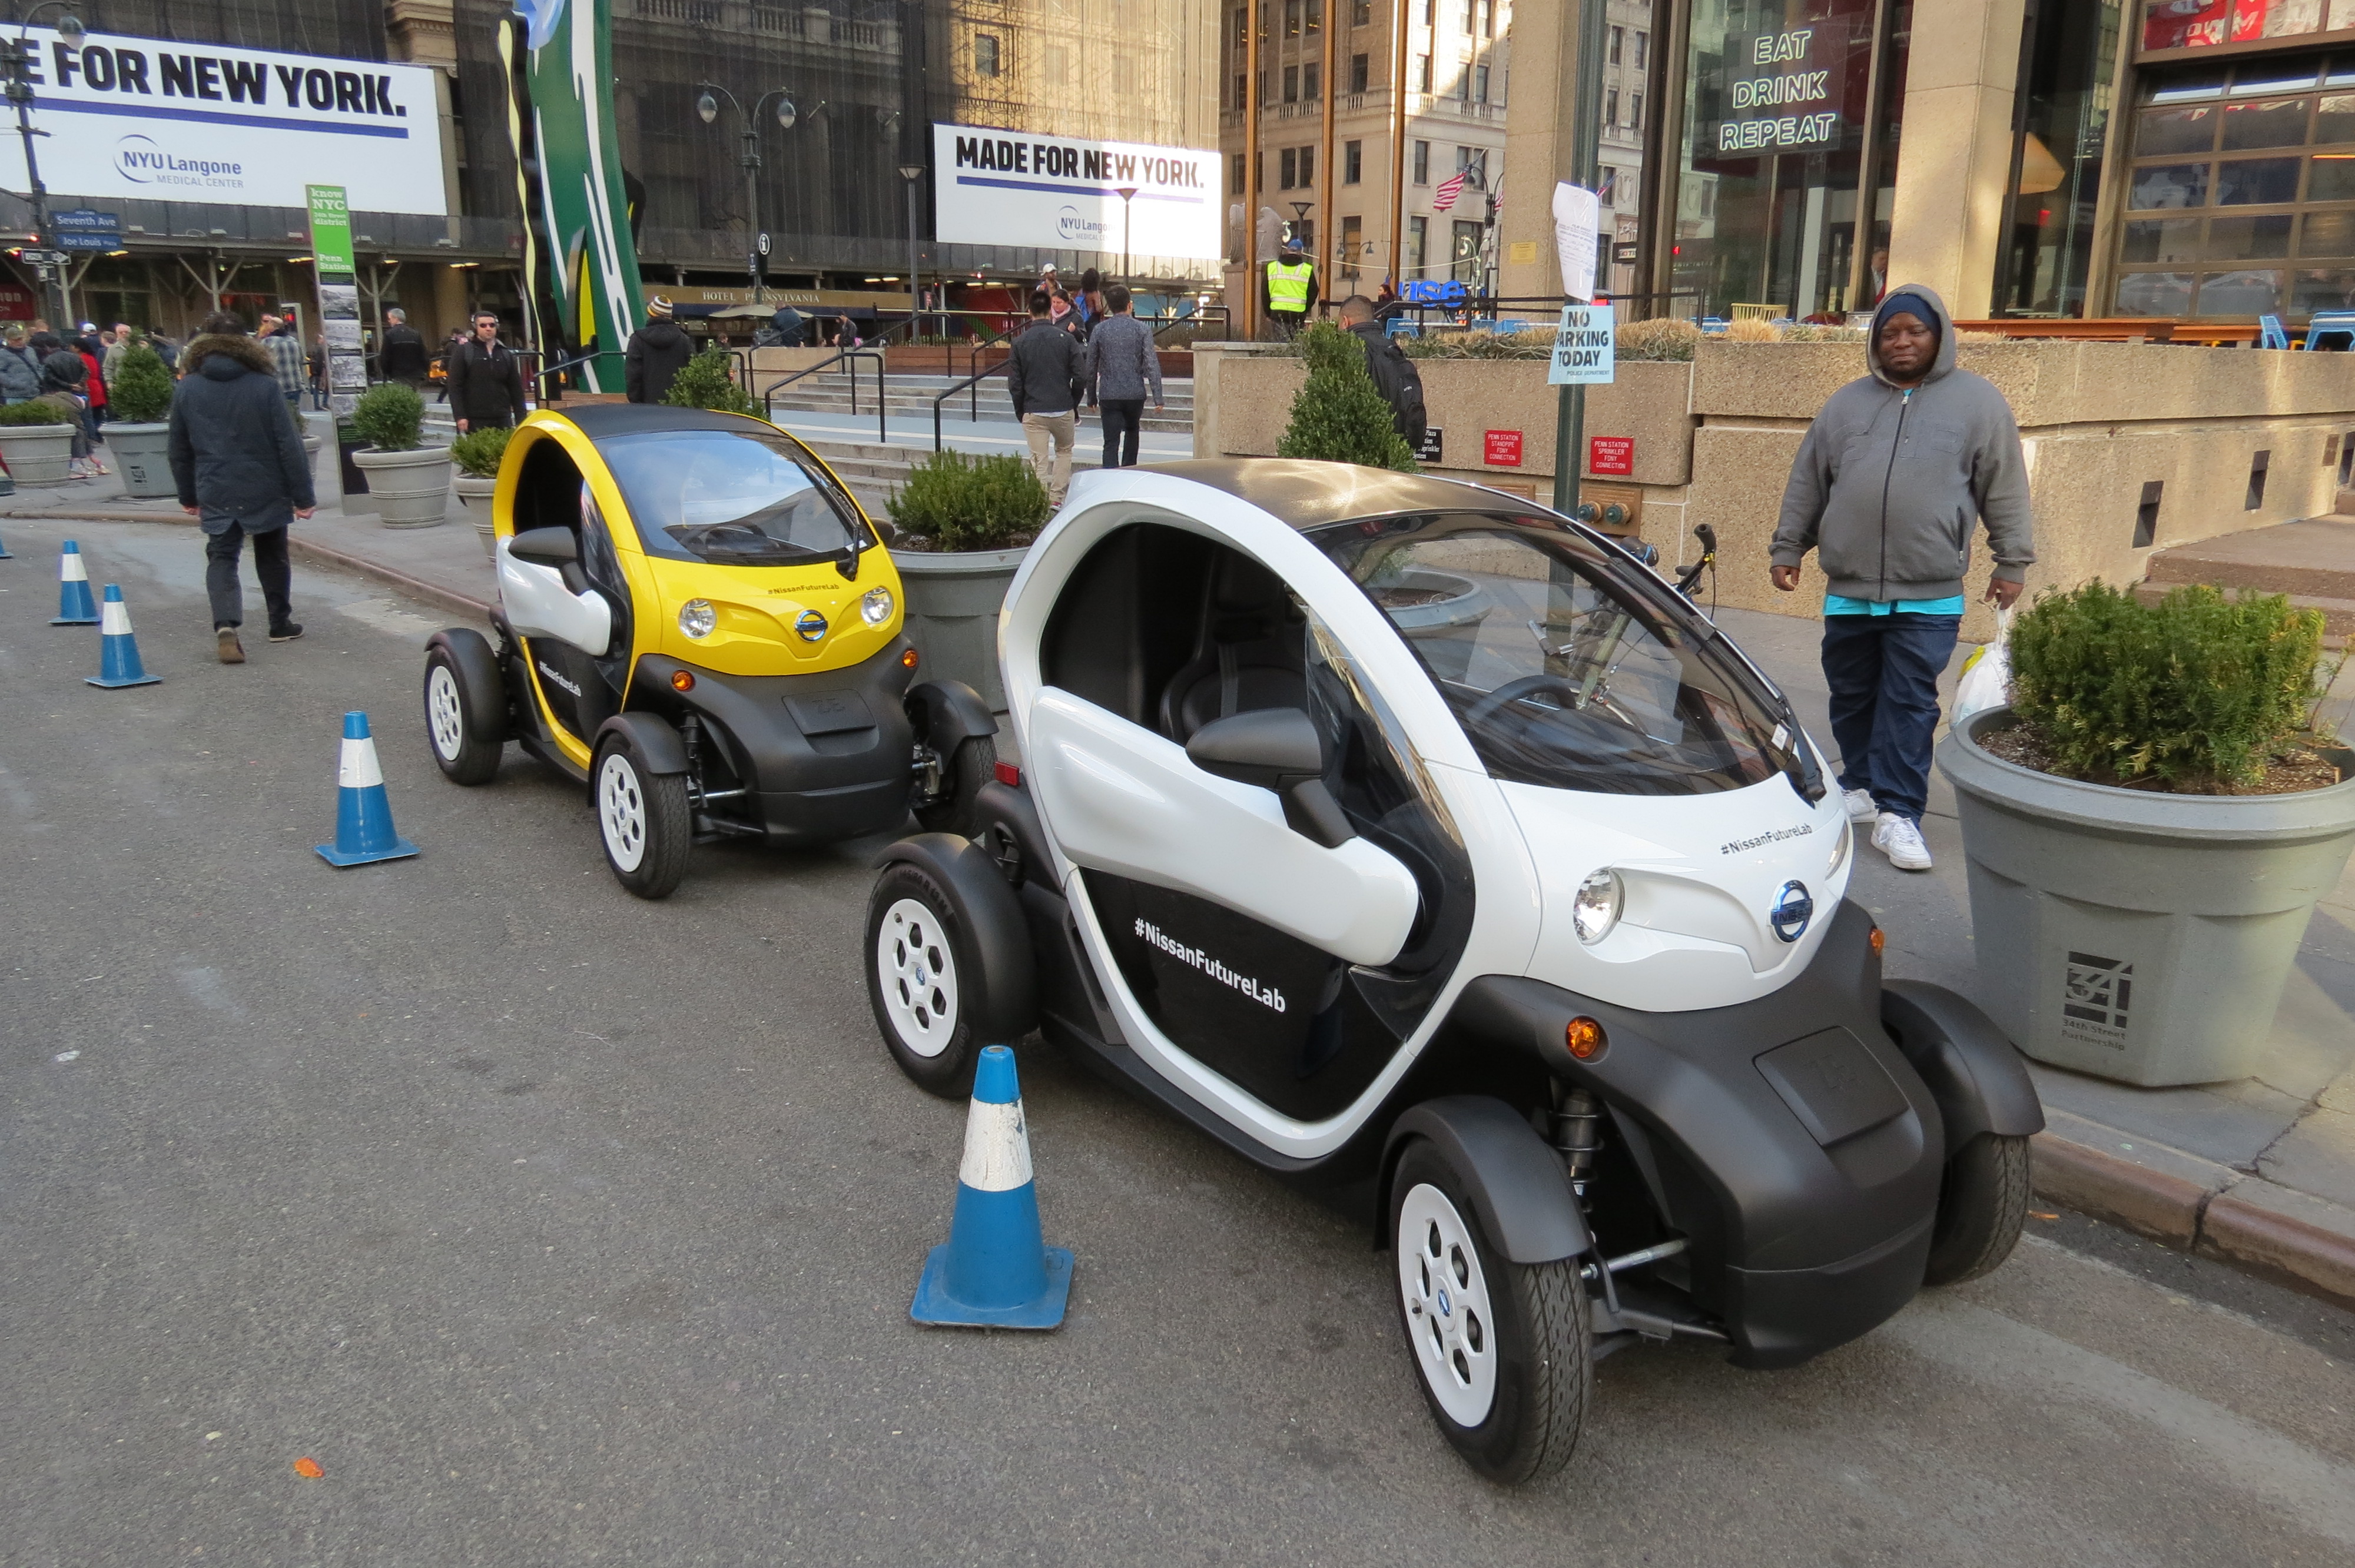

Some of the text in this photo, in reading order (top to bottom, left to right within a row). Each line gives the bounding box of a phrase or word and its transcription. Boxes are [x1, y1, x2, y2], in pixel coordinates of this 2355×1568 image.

[1754, 30, 1812, 65] EAT
[52, 41, 151, 95] FOR
[158, 54, 268, 105] NEW
[274, 65, 407, 117] YORK.
[1733, 71, 1829, 108] DRINK
[1719, 113, 1836, 151] REPEAT
[123, 151, 243, 176] NYU Langone
[956, 135, 1205, 188] MADE FOR NEW YORK.
[156, 174, 244, 188] MEDICAL CENTER
[310, 188, 344, 198] know
[311, 199, 346, 211] NYC
[57, 215, 116, 227] Seventh Ave
[314, 218, 347, 227] district
[1061, 217, 1081, 230] NYU
[62, 237, 77, 246] Joe
[79, 238, 102, 247] Louis
[318, 254, 343, 262] Penn
[319, 262, 353, 271] Station
[703, 291, 820, 303] HOTEL PENSYLVANIA
[1568, 311, 1591, 327] NO
[1558, 350, 1601, 367] TODAY
[767, 583, 840, 594] #NissanFutureLab
[1720, 823, 1813, 855] #NissanFutureLab
[1134, 917, 1286, 1014] #NissanFutureLab
[2062, 1017, 2126, 1040] 34th Street
[2061, 1029, 2125, 1051] Partnership
